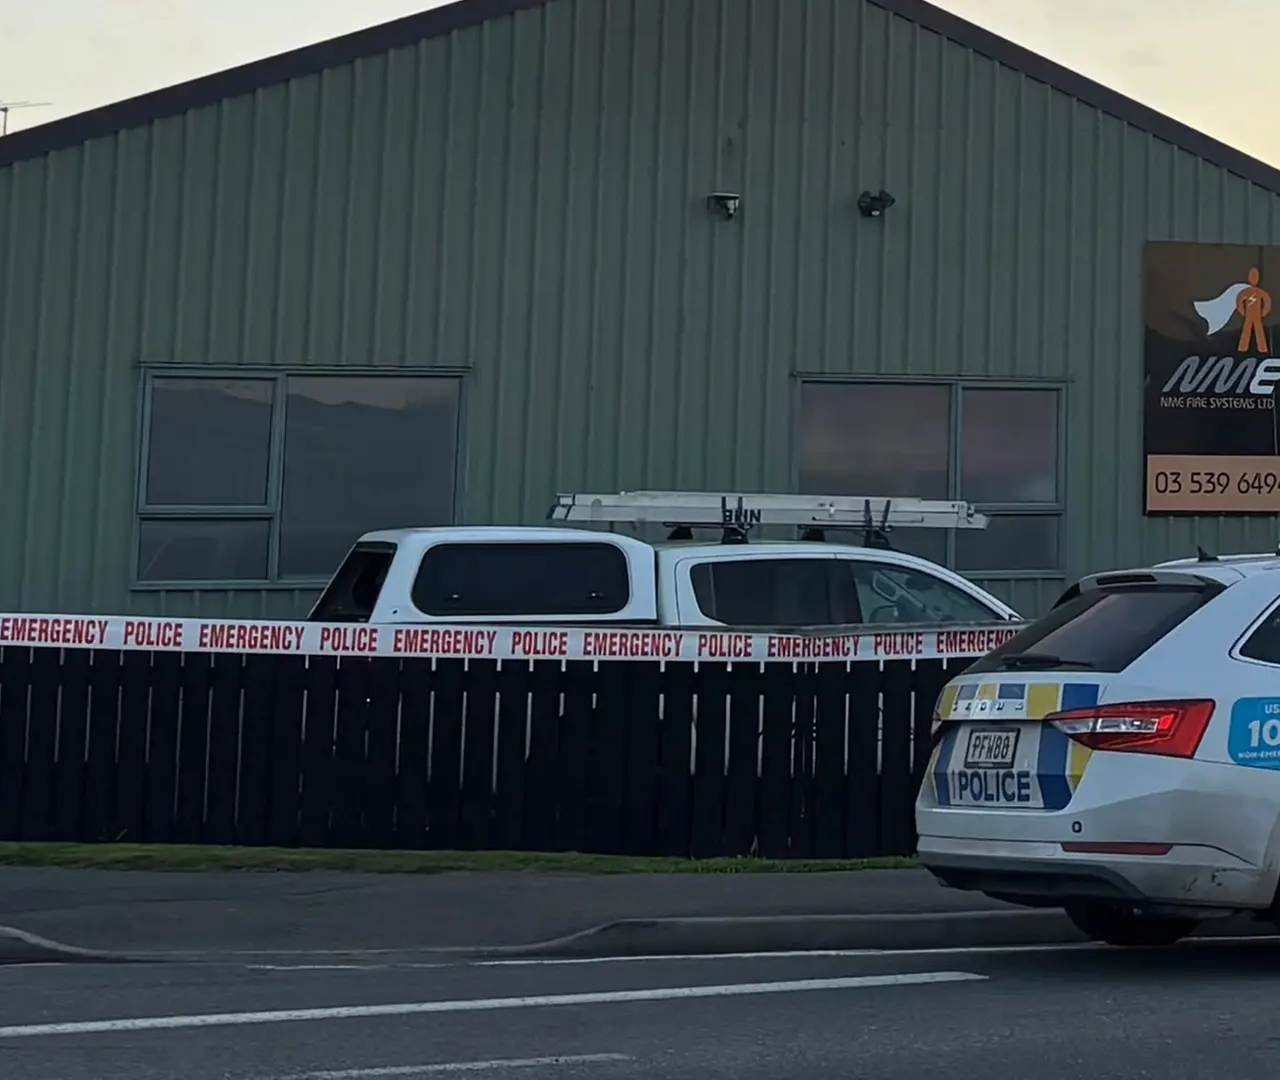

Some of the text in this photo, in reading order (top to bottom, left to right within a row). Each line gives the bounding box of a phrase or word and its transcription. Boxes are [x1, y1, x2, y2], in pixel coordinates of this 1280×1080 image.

[1160, 396, 1275, 410] NME FIRE SYSTEMS LTD
[1154, 471, 1182, 494] 03
[1189, 471, 1230, 494] 539
[0, 618, 110, 645] EMERGENCY
[123, 621, 183, 647] POLICE
[198, 623, 305, 651] EMERGENCY
[319, 627, 378, 652] POLICE
[393, 629, 497, 655] EMERGENCY
[511, 631, 568, 656] POLICE
[583, 632, 683, 657] EMERGENCY
[698, 633, 753, 658] POLICE
[767, 636, 860, 658] EMERGENCY
[873, 632, 924, 657] POLICE
[959, 770, 1031, 802] POLICE
